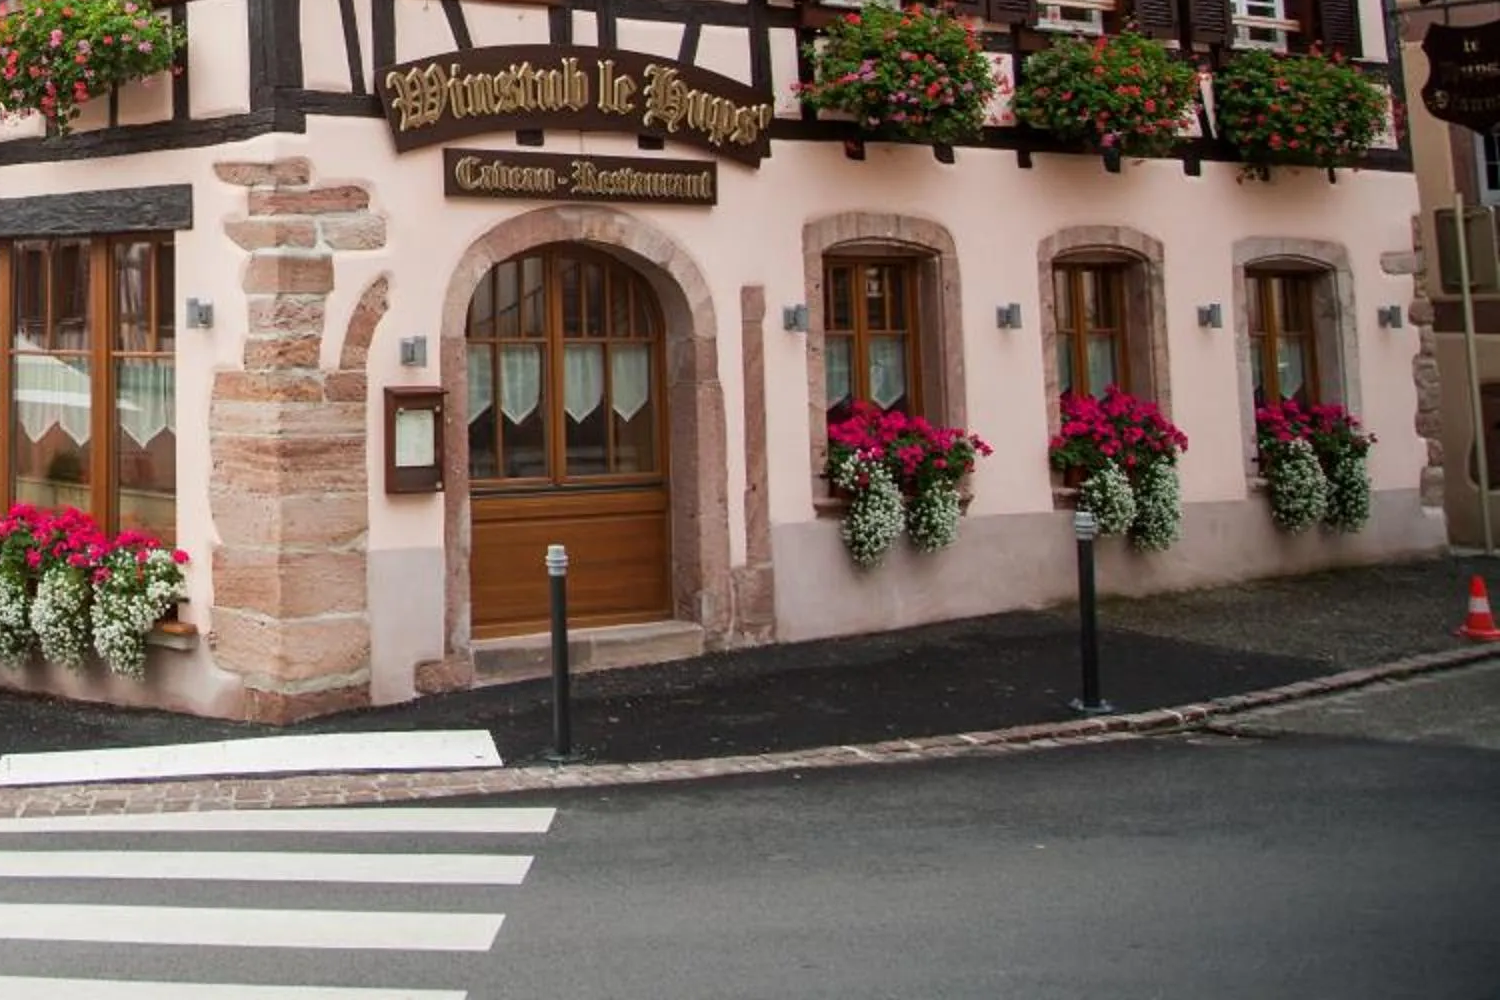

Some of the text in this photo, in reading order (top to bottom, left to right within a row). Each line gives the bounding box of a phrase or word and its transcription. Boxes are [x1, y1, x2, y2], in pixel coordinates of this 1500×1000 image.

[386, 57, 590, 132] Winstub
[597, 59, 637, 116] le
[571, 159, 713, 200] Restaurant
